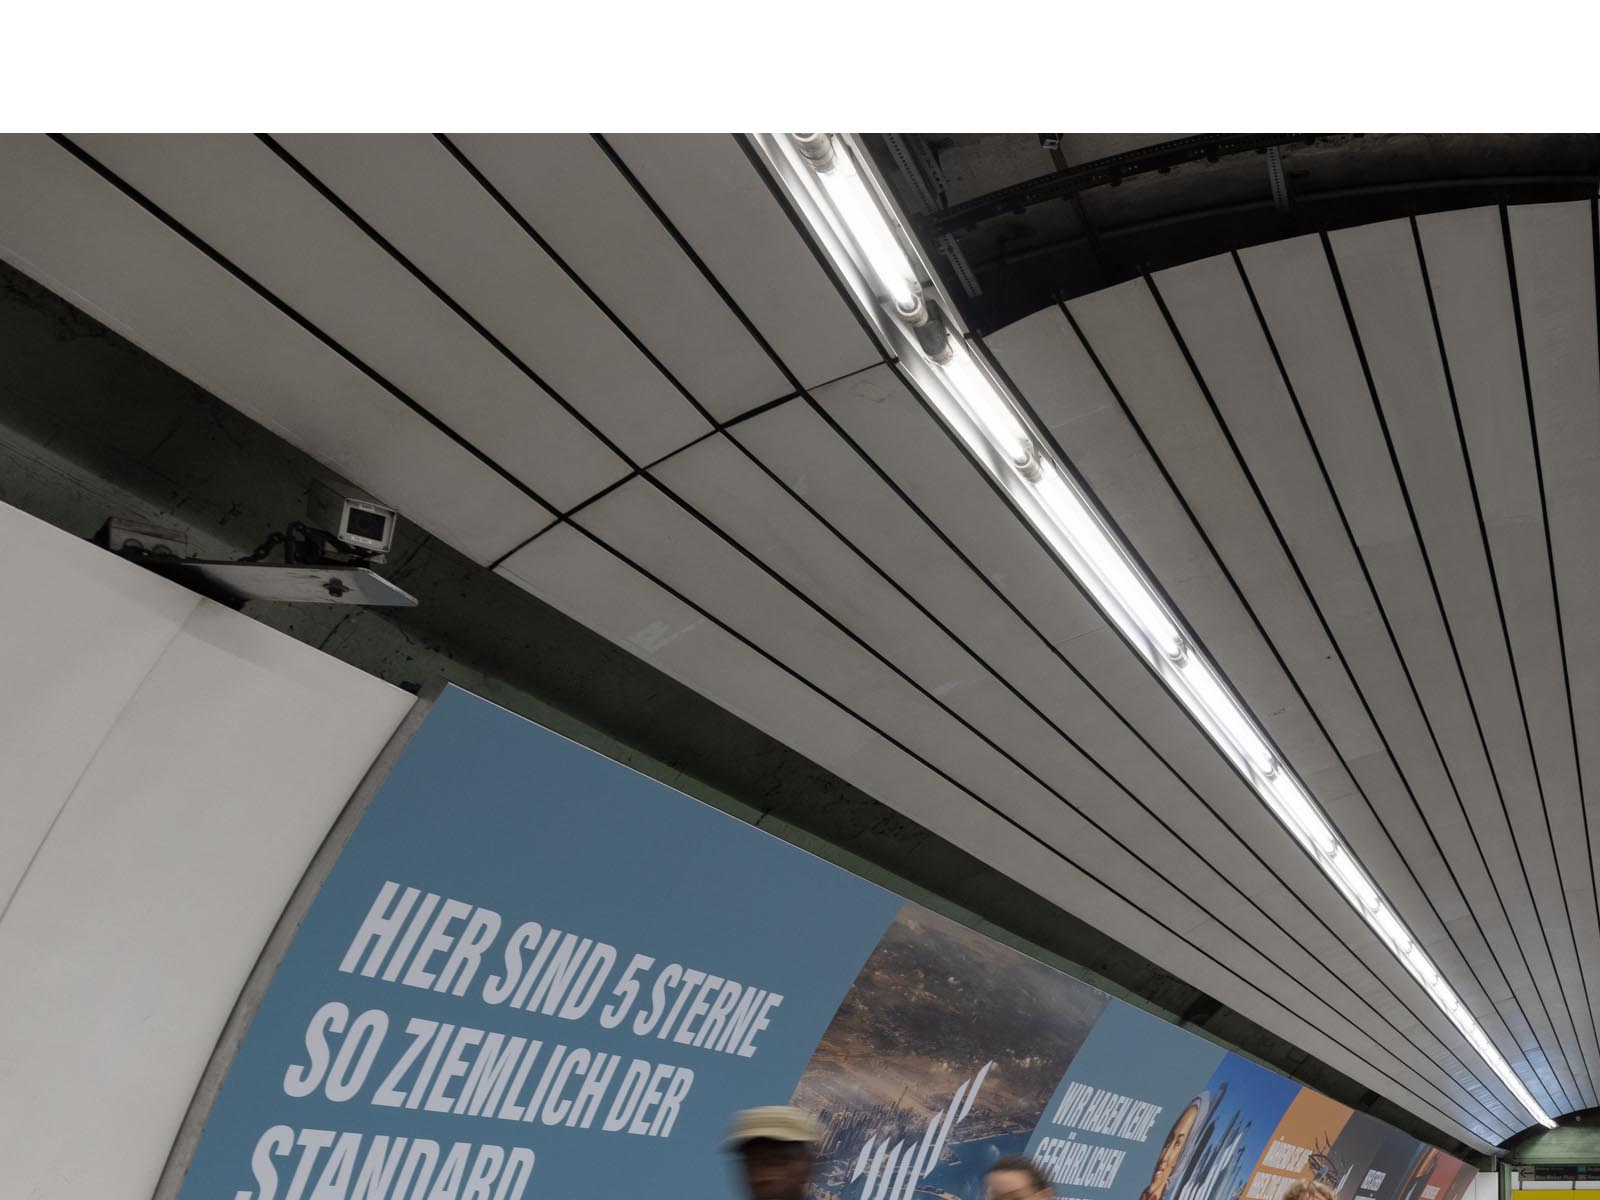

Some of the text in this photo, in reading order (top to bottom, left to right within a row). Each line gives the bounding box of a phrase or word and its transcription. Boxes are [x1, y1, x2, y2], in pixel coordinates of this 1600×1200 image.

[338, 881, 784, 1058] HIER SIND 5 STERNE
[283, 1001, 694, 1138] SO ZIEMLICH DER
[1052, 1081, 1163, 1143] WIR HABEN KEINE
